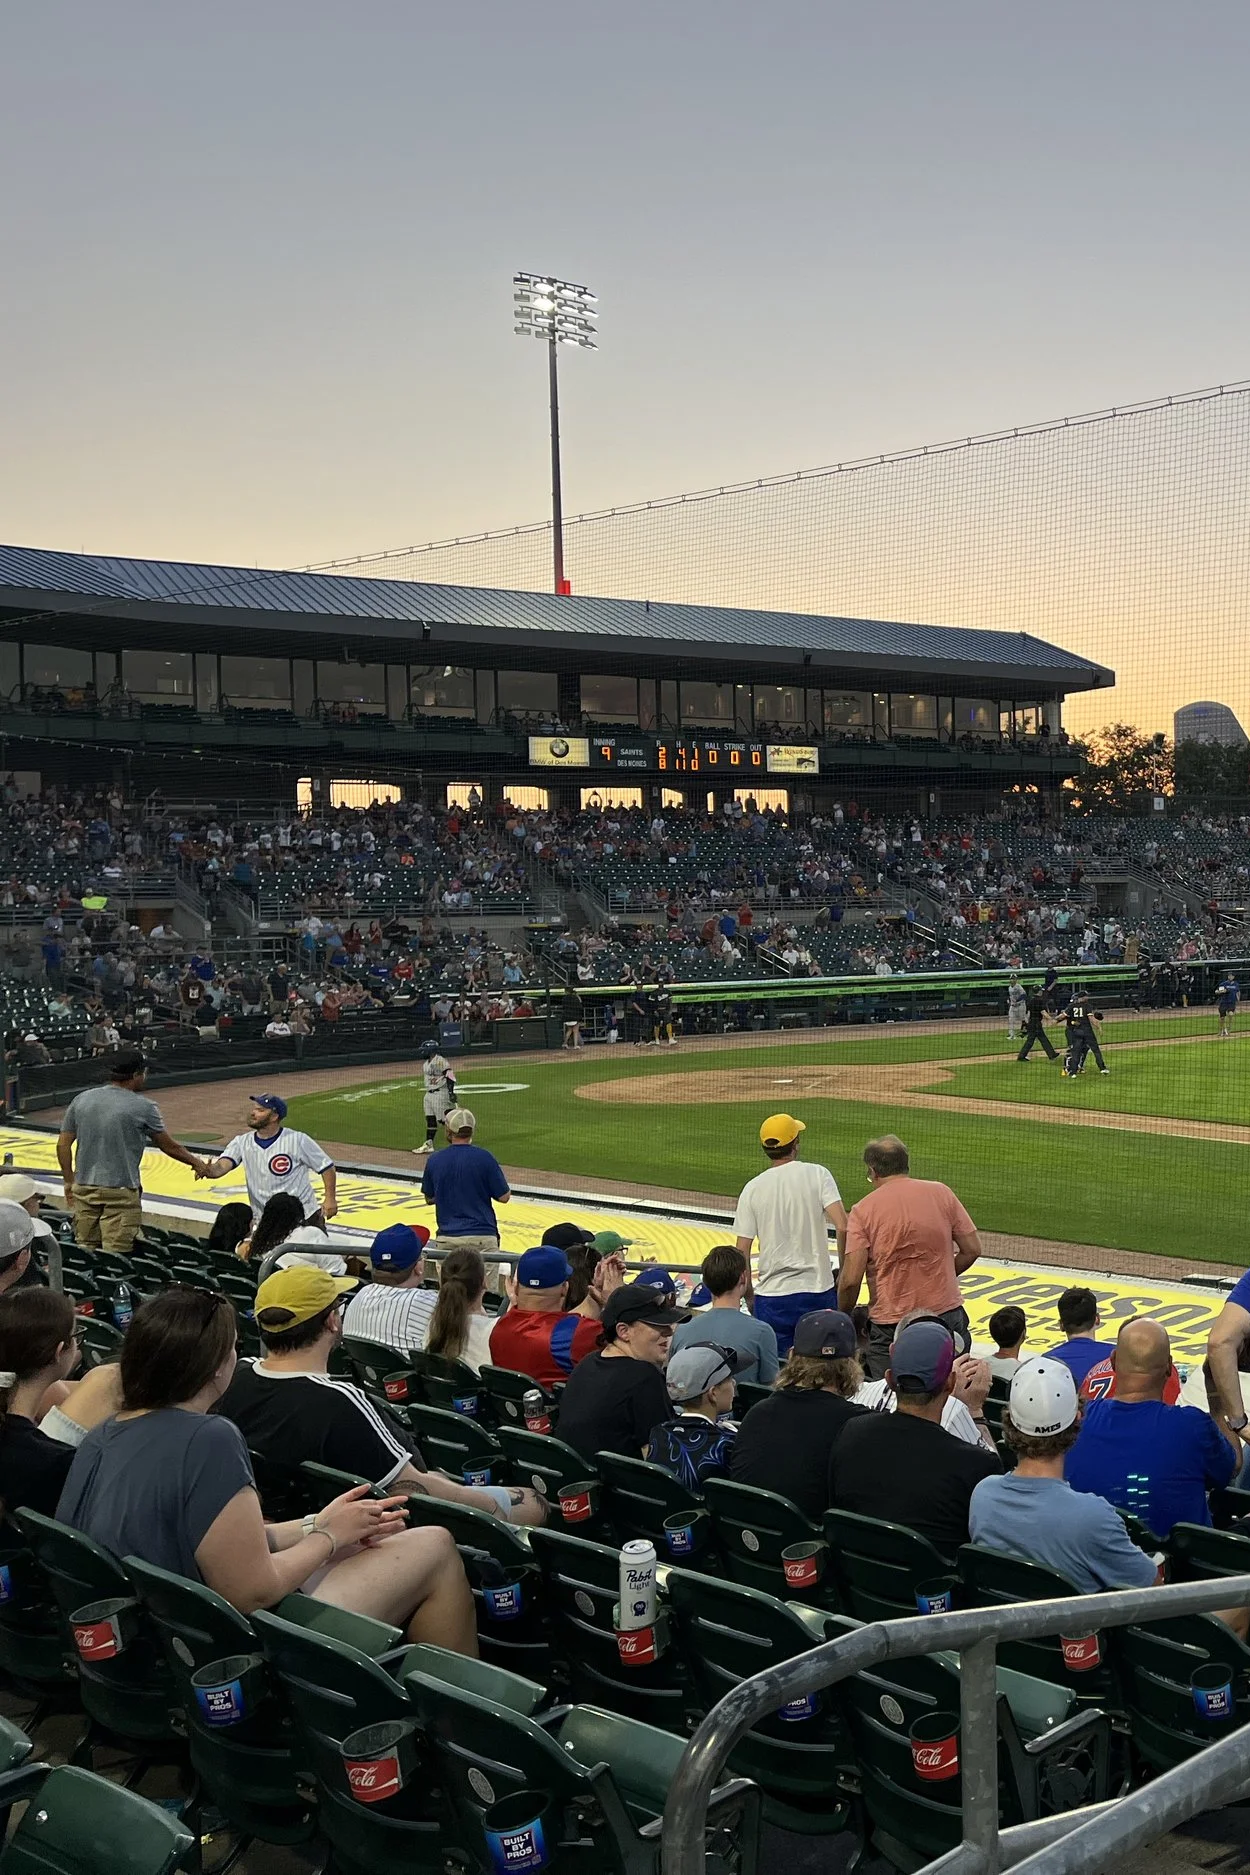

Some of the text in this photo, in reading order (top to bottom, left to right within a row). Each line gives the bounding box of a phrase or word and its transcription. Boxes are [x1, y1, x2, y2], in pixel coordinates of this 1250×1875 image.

[593, 737, 615, 746] INNING
[705, 742, 720, 750] BALL
[724, 743, 746, 751] STRIKE
[602, 747, 610, 760] 9
[659, 747, 666, 758] 2
[709, 750, 717, 763] 0
[731, 751, 739, 764] 0
[752, 751, 760, 765] 0
[659, 758, 666, 769] 8
[691, 759, 698, 771] 0
[1073, 1007, 1084, 1018] 21
[1034, 1422, 1061, 1434] AMES
[626, 1568, 652, 1583] Pabst
[629, 1581, 650, 1590] Light
[494, 1591, 512, 1599] BUILT
[1065, 1643, 1086, 1658] Cola
[206, 1690, 230, 1701] BUILT
[210, 1702, 232, 1711] PROS
[916, 1747, 943, 1766] Cola
[349, 1766, 378, 1787] Cola
[503, 1832, 531, 1846] BUILT
[512, 1842, 524, 1851] BY
[507, 1846, 532, 1860] PROS
